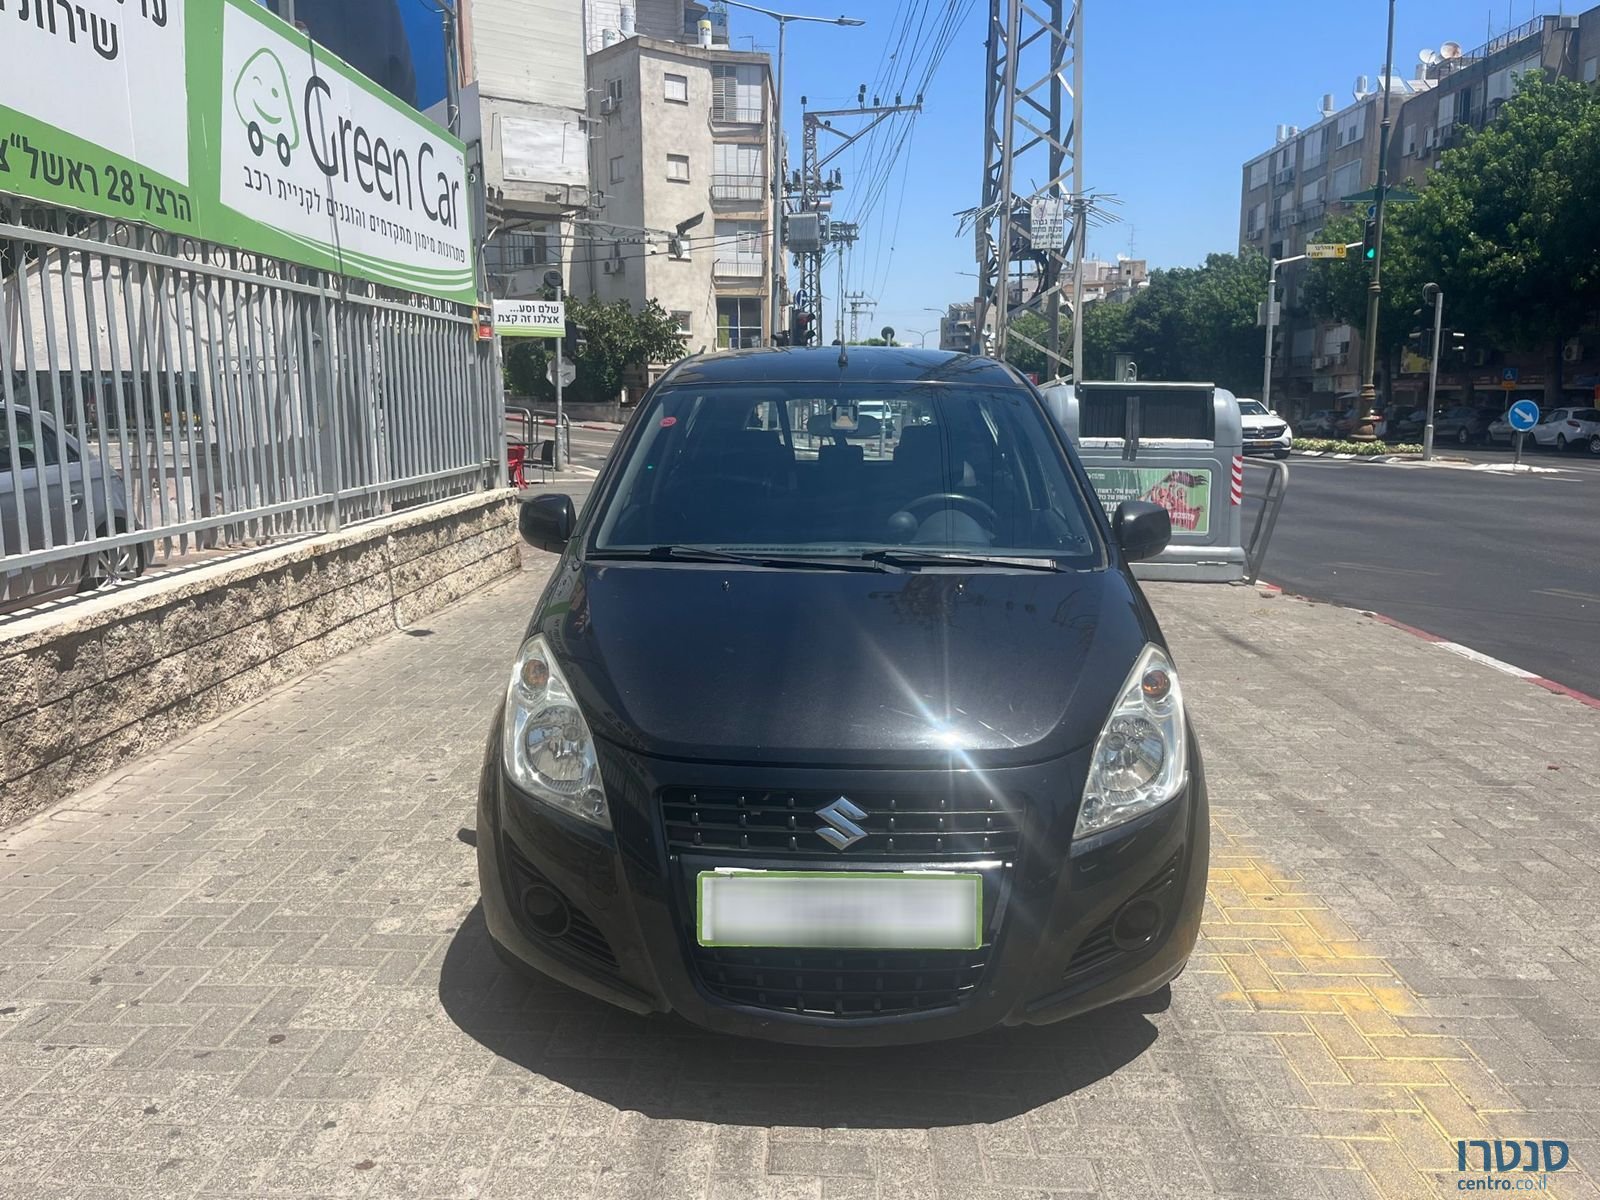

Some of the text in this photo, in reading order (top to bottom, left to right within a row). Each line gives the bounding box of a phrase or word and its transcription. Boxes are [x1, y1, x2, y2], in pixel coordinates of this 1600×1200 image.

[18, 0, 118, 60] שירות
[304, 75, 459, 230] Green Car
[105, 165, 135, 206] 28
[139, 173, 192, 222] הרצל
[243, 165, 465, 263] פתרונות מימון מתקדמים והוגנים לקניית רכב
[497, 314, 560, 324] אצלנו זה קצת
[509, 304, 559, 314] שלם וסע...
